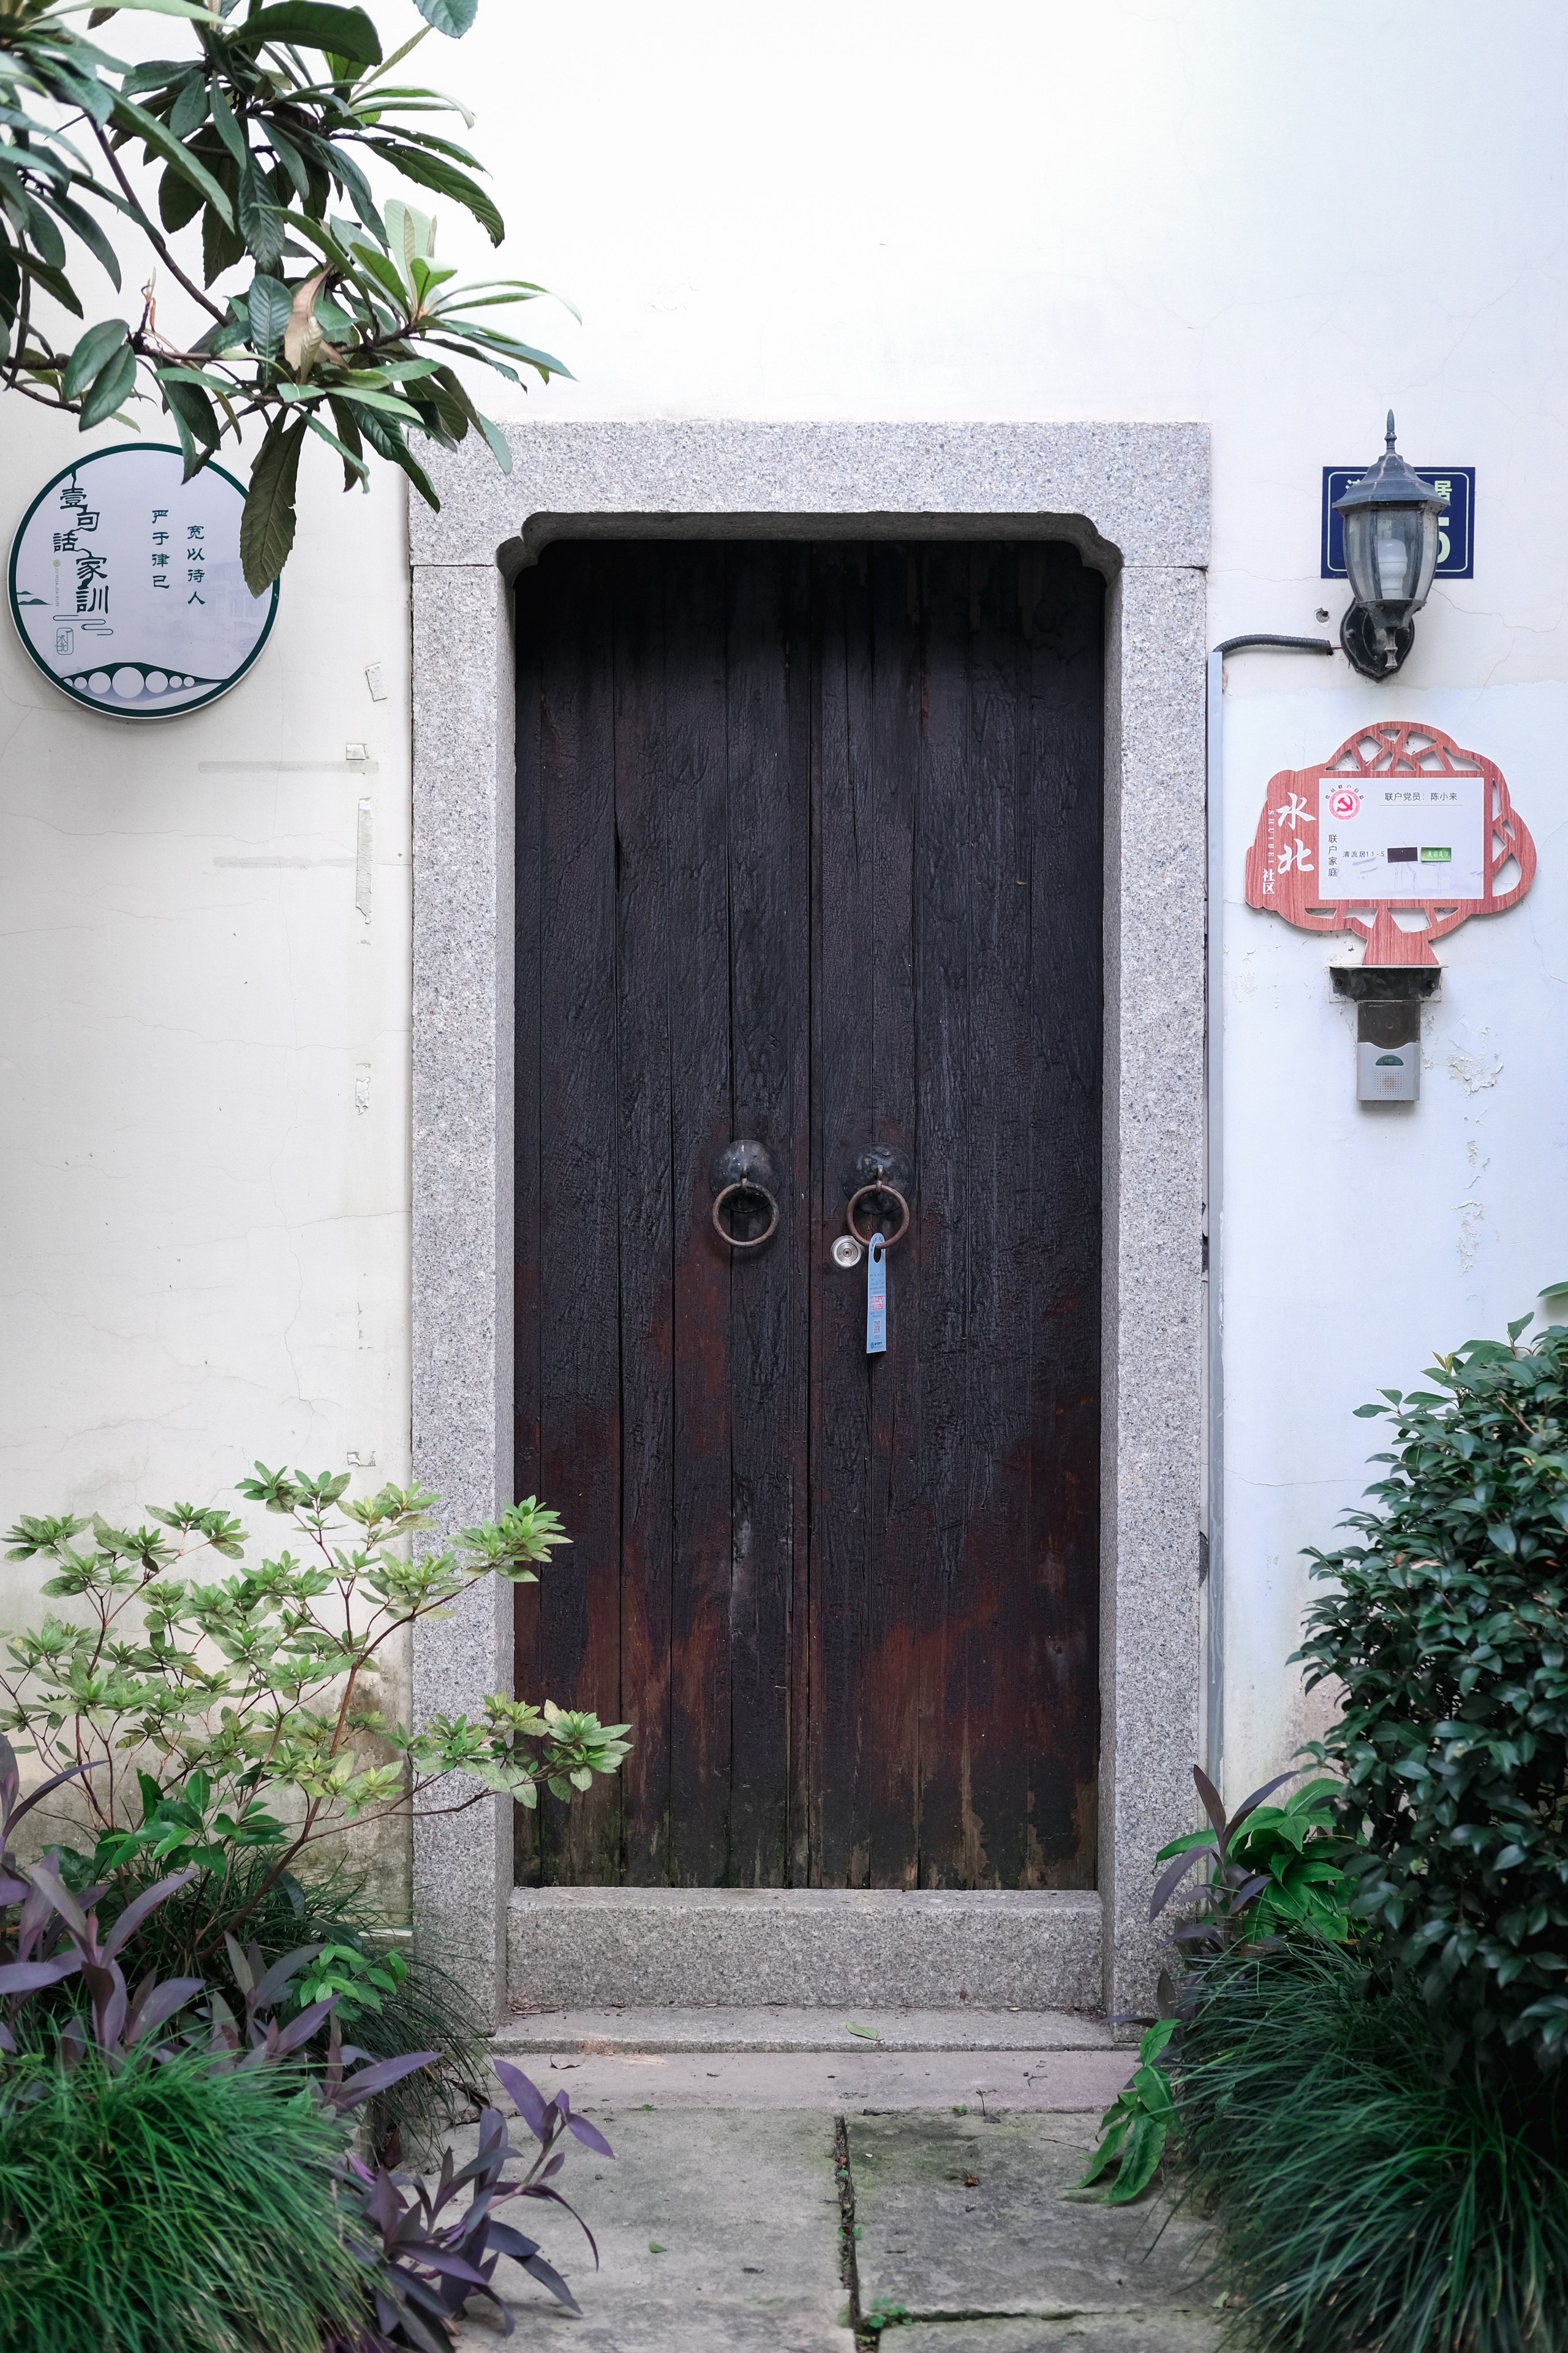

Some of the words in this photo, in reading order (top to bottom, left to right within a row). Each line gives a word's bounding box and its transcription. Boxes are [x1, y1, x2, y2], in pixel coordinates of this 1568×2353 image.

[151, 509, 170, 589] 严于律己
[187, 525, 206, 605] 宽以待人
[1276, 791, 1317, 874] 水北
[1328, 834, 1338, 877] 联户家庭
[1262, 869, 1275, 894] 社区
